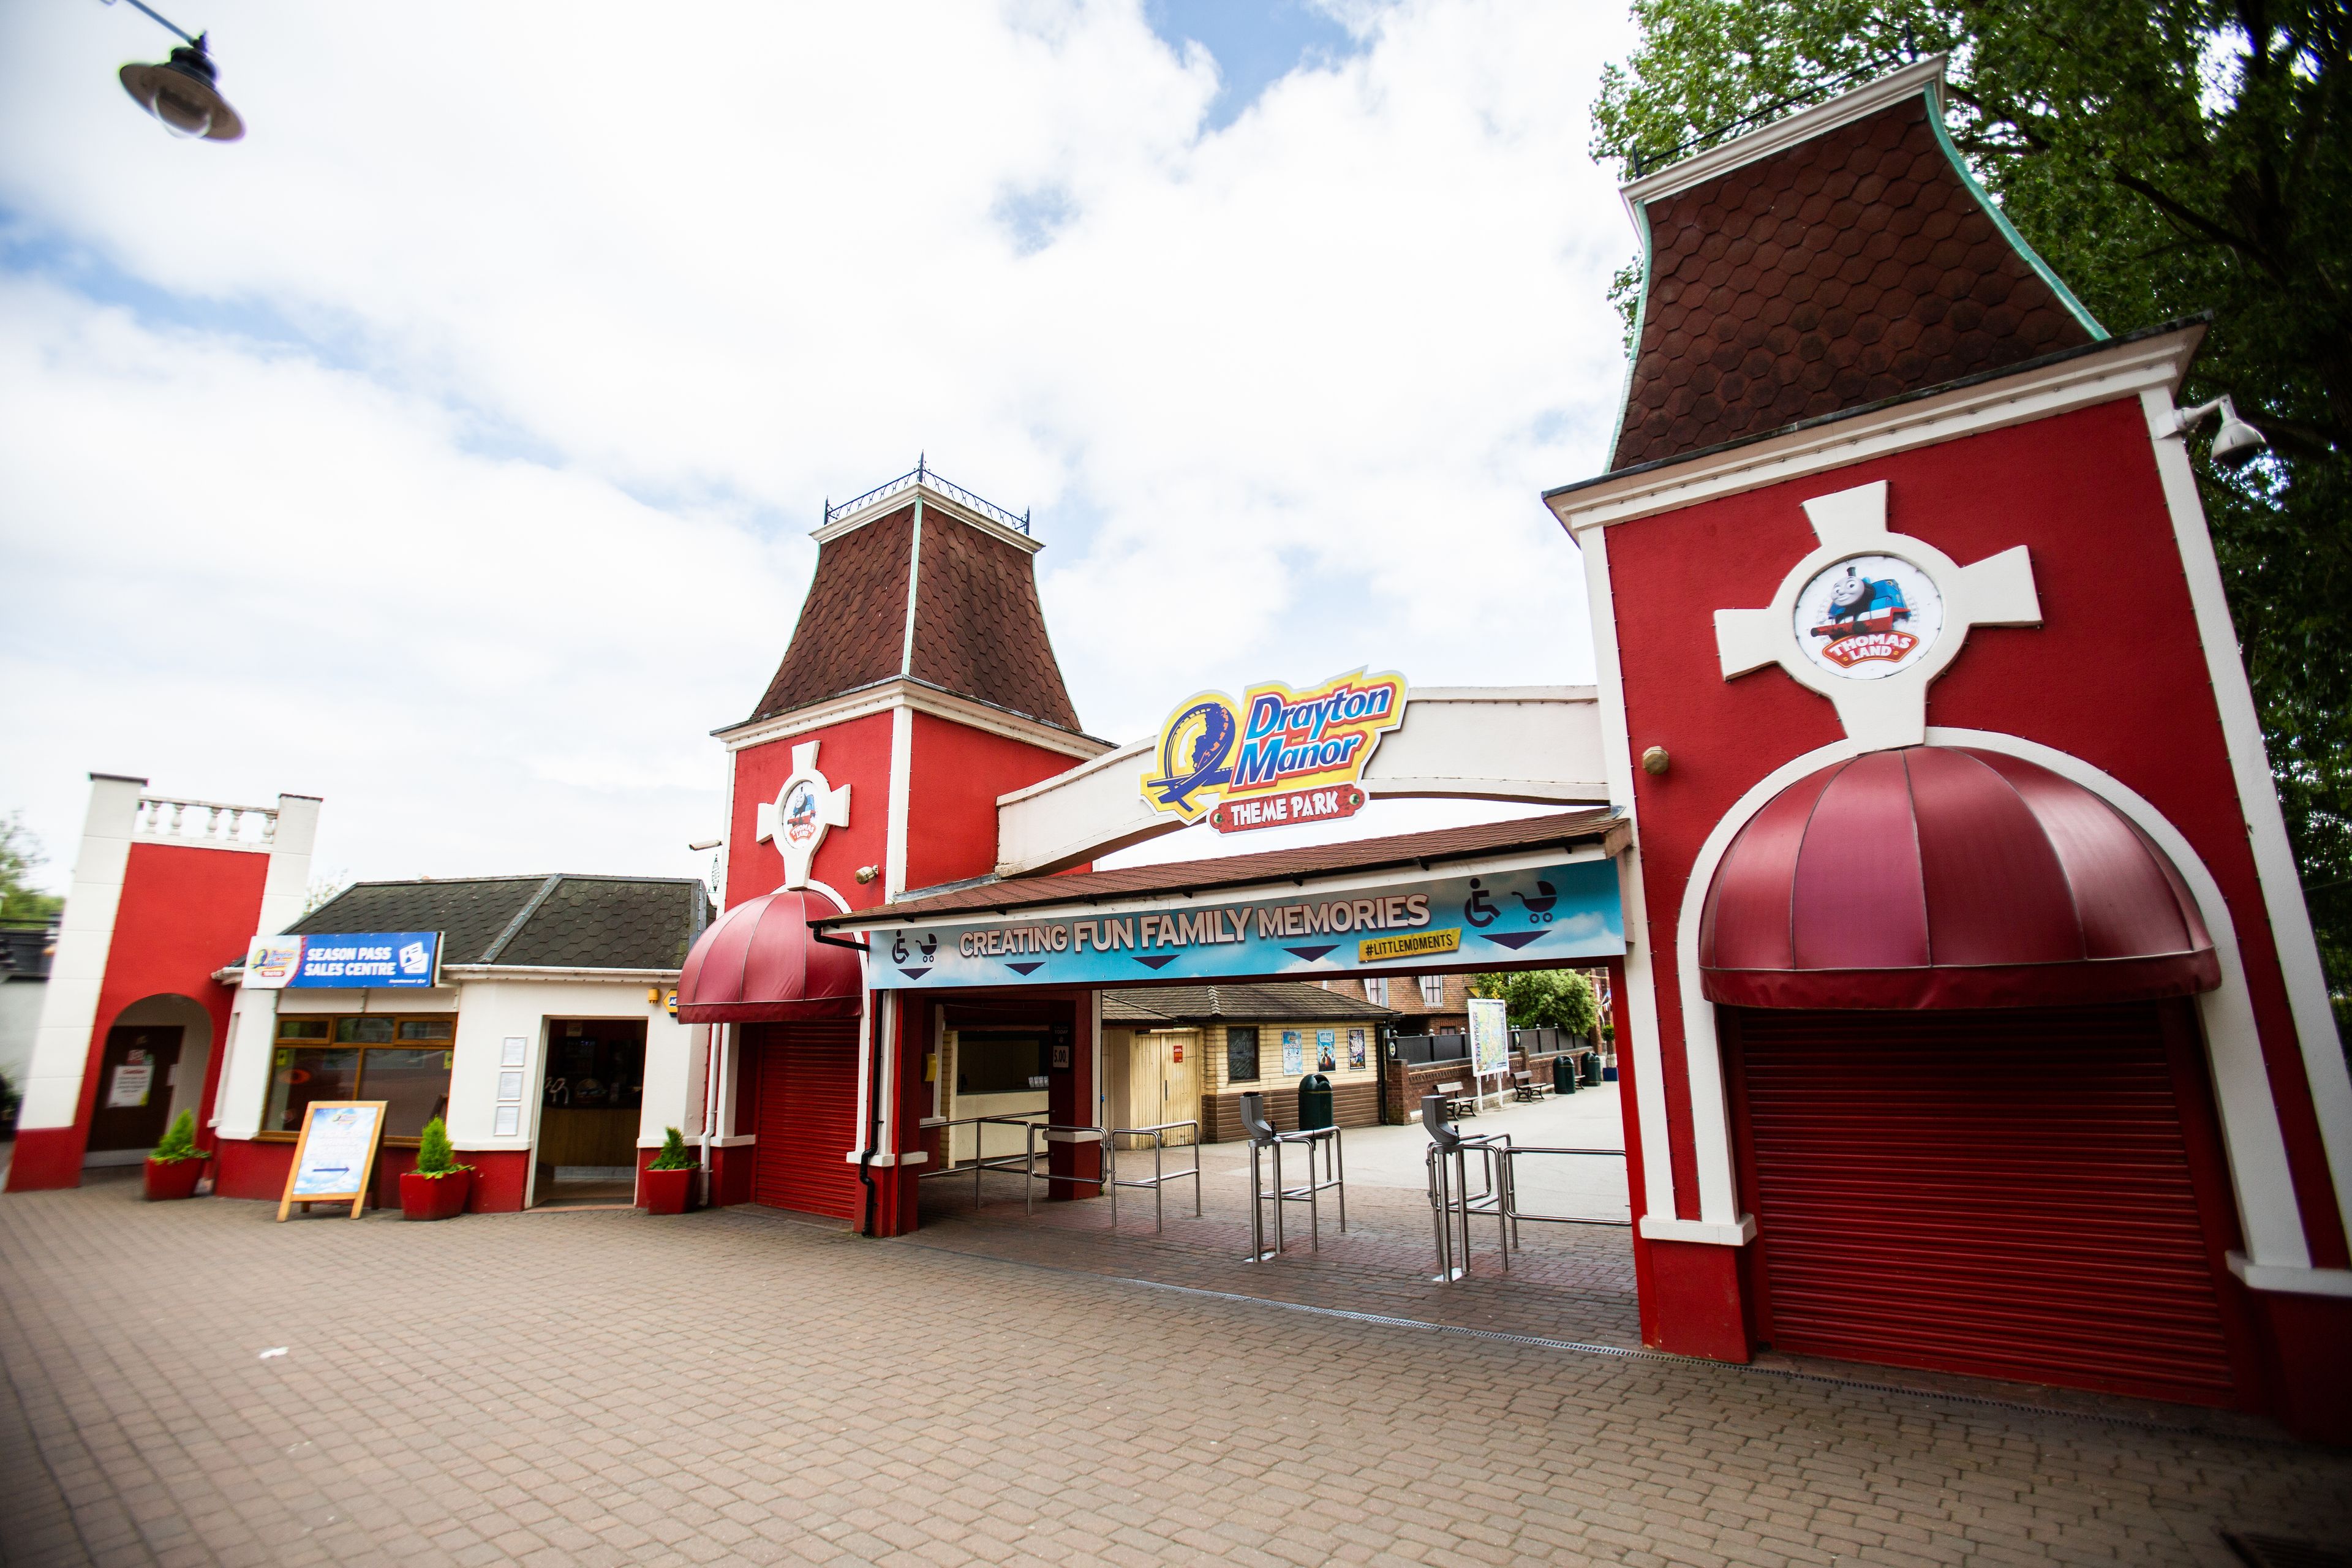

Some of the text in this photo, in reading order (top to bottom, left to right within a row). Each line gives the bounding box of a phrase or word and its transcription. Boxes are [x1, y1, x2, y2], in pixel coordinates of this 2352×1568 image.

[1828, 633, 1912, 656] THOMAS
[1850, 645, 1891, 660] LAND
[1245, 687, 1392, 740] Drayton
[1234, 734, 1360, 785] Manor
[1231, 791, 1339, 826] THEME PARK
[791, 824, 815, 835] THOMAS
[797, 830, 809, 839] LAND
[959, 894, 1431, 956] CREATING FUN FAMILY MEMORIES
[307, 946, 393, 962] SEASON PASS
[1365, 933, 1453, 957] #LITTLEMOMENTS
[304, 962, 397, 976] SALES CENTRE
